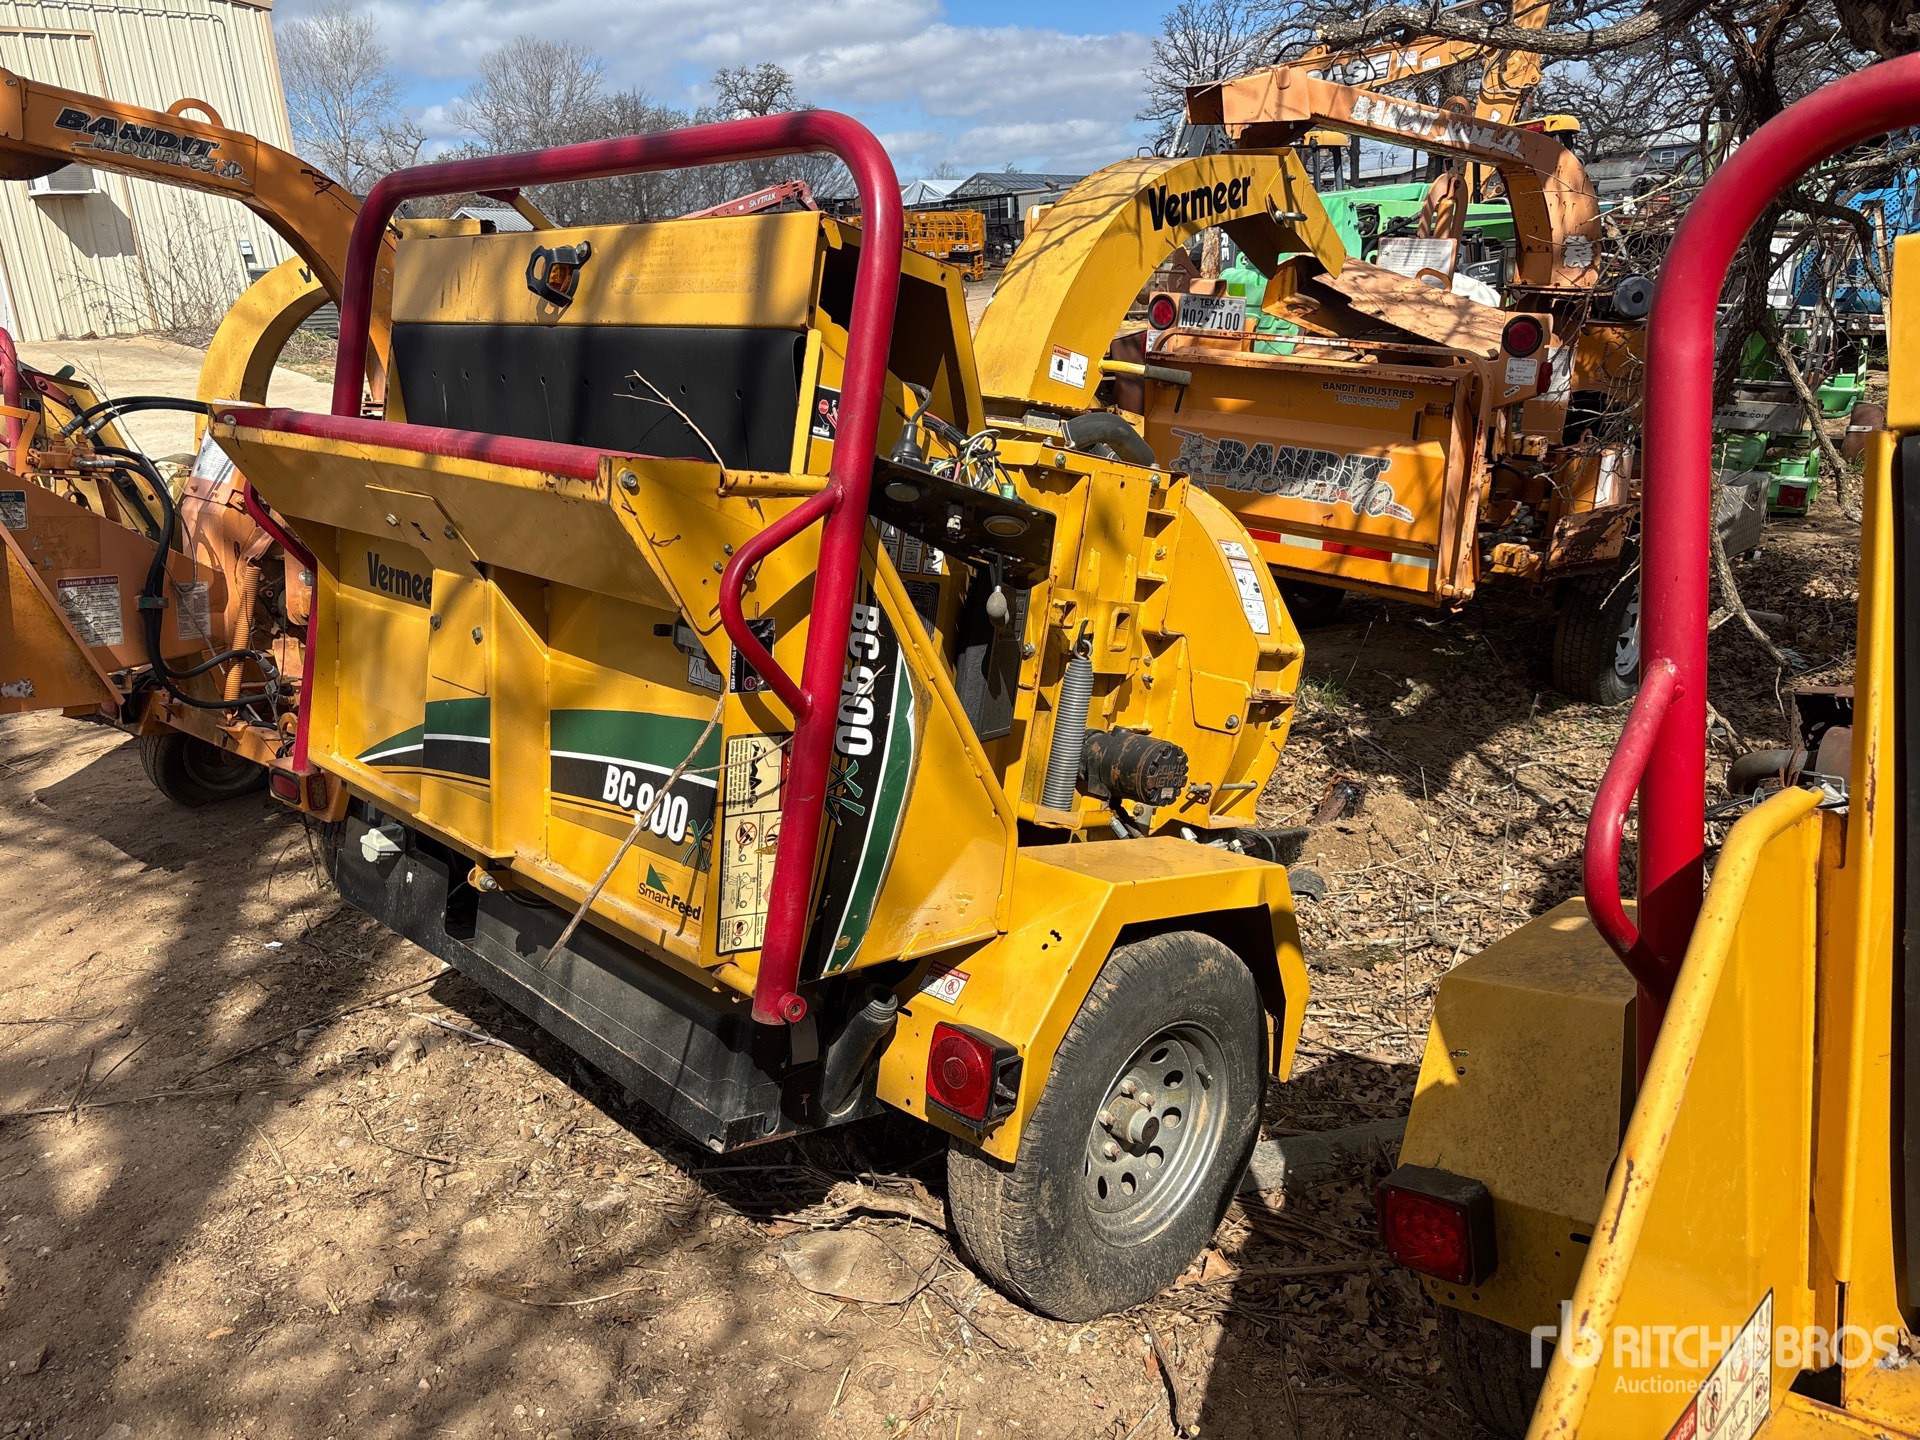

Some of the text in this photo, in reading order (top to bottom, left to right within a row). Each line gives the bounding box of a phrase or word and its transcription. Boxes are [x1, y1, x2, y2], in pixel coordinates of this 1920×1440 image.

[54, 107, 220, 156] BANDIT
[94, 130, 182, 166] MODEL
[748, 192, 777, 208] SKYTRAK
[1147, 175, 1251, 232] Vermeer
[1200, 298, 1225, 308] TEXAS
[1210, 311, 1240, 331] 7100
[1322, 381, 1415, 399] BANDIT INDUSTRIES
[1211, 438, 1391, 489] BANDIT
[1225, 471, 1340, 505] MODEL
[367, 550, 433, 605] Vermee
